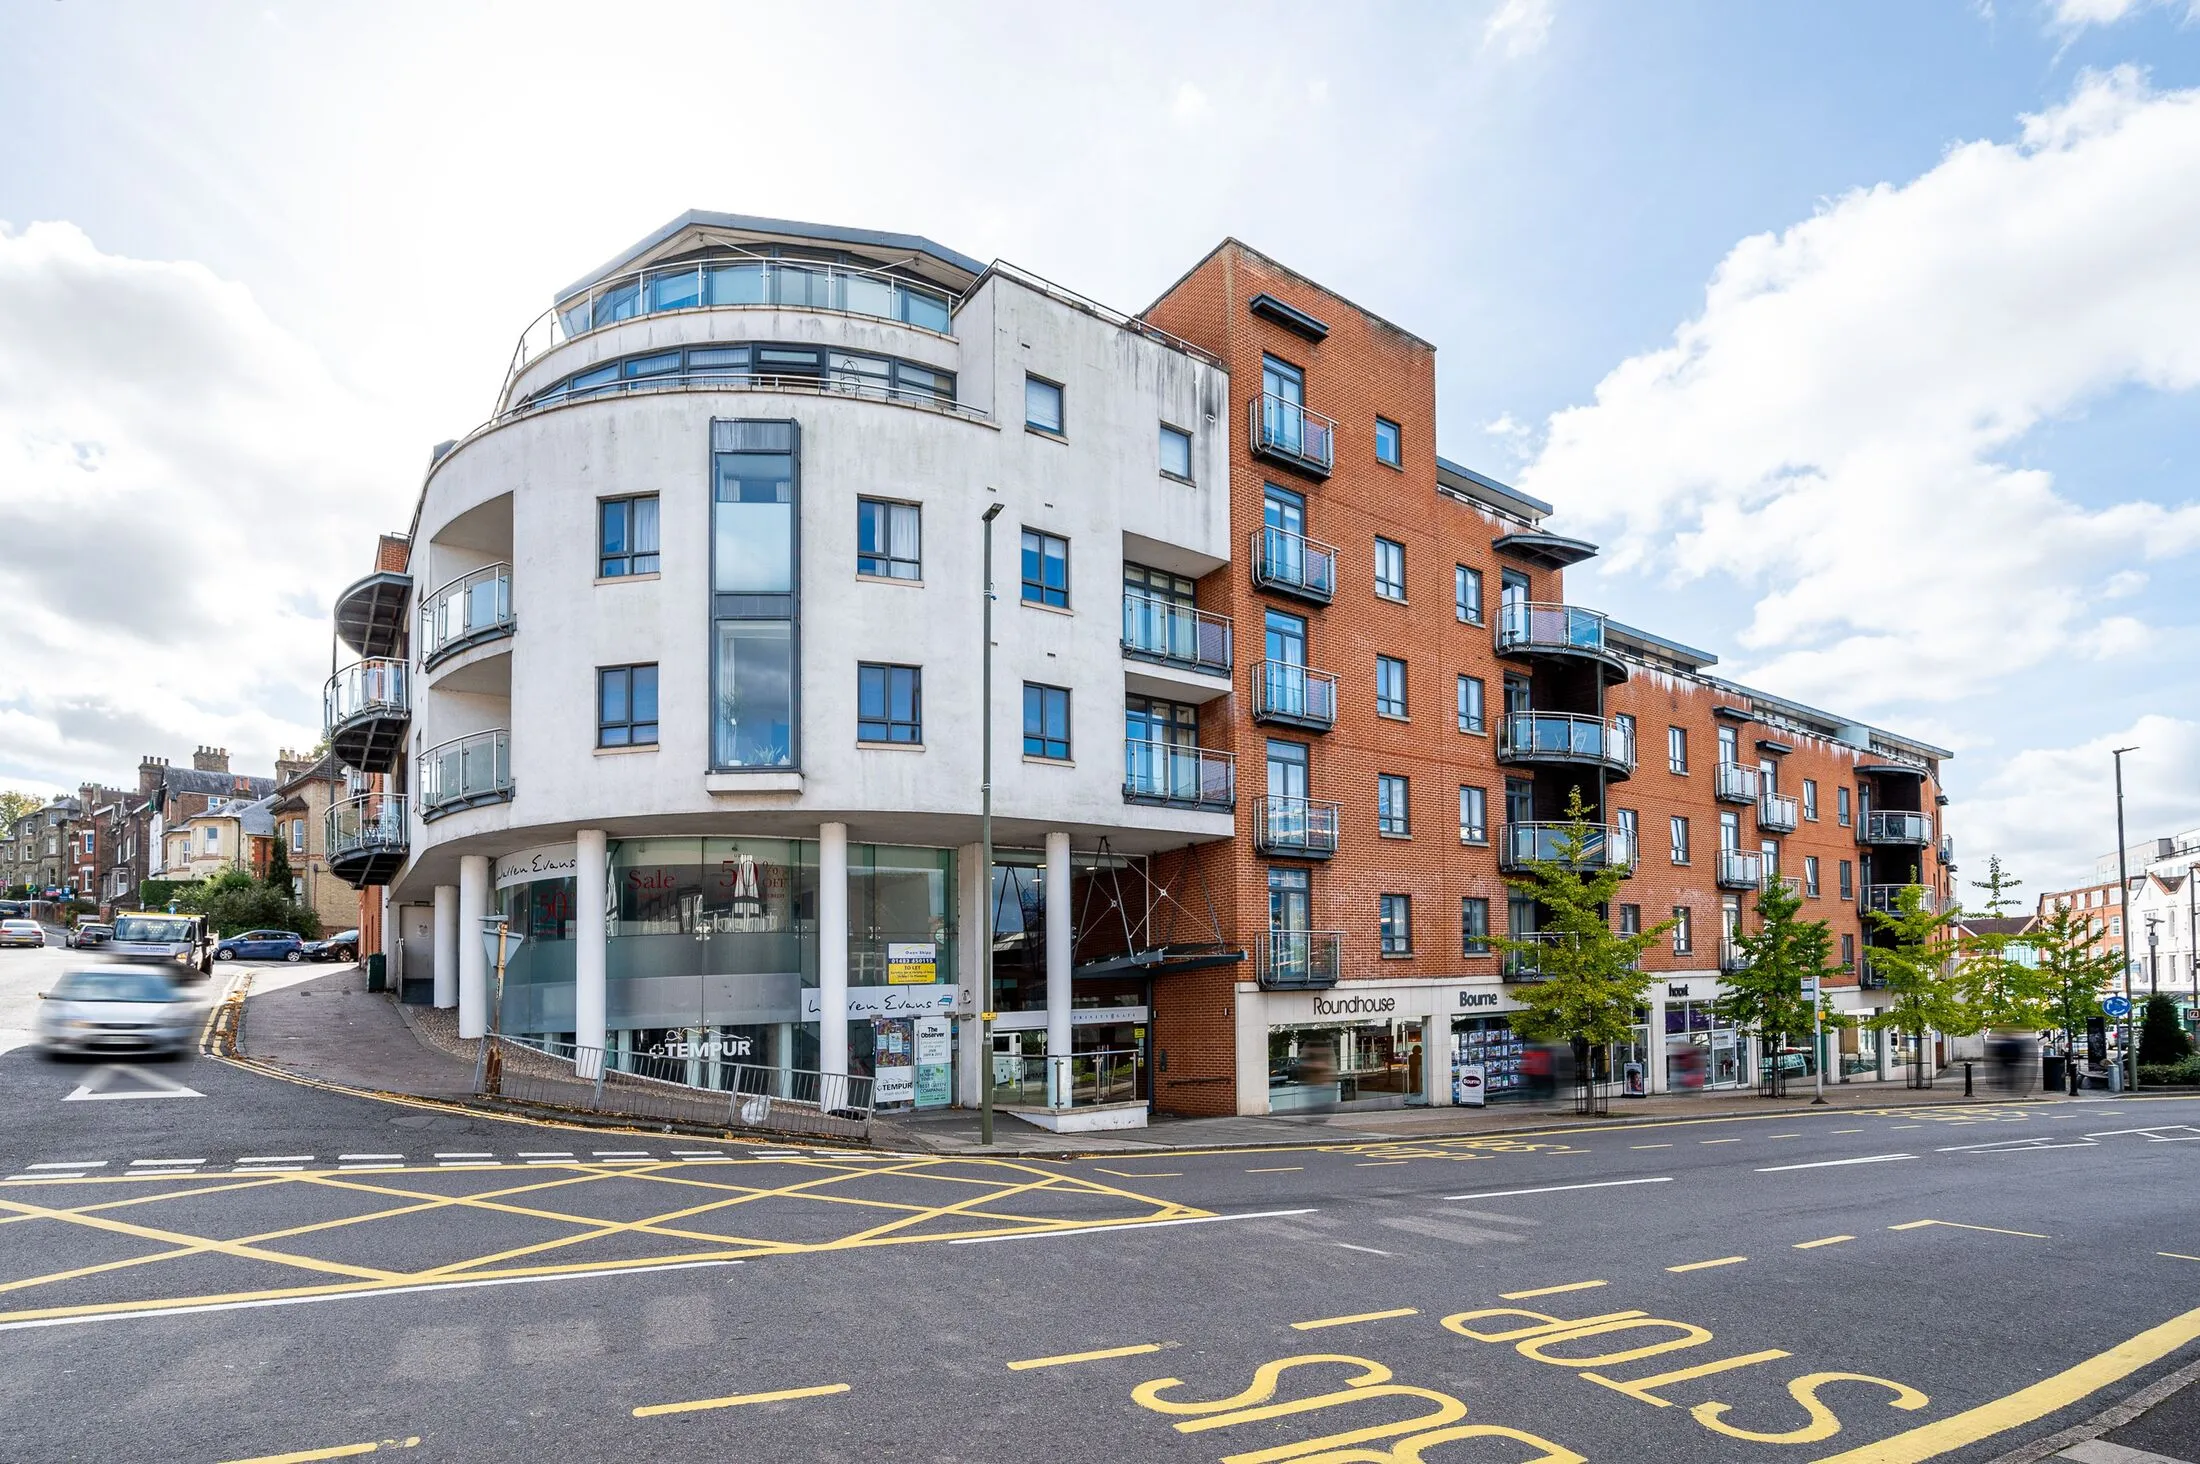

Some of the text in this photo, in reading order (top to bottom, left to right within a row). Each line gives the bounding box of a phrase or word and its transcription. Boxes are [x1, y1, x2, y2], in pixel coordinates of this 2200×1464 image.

[532, 854, 576, 872] Evans
[628, 869, 676, 890] Sale
[884, 994, 932, 1010] Evans
[1313, 996, 1395, 1015] Roundhouse
[1459, 991, 1497, 1007] Bourne
[664, 1040, 751, 1058] TEMPUR
[882, 1081, 913, 1091] TEMPUR
[1440, 1307, 1930, 1444] STOP
